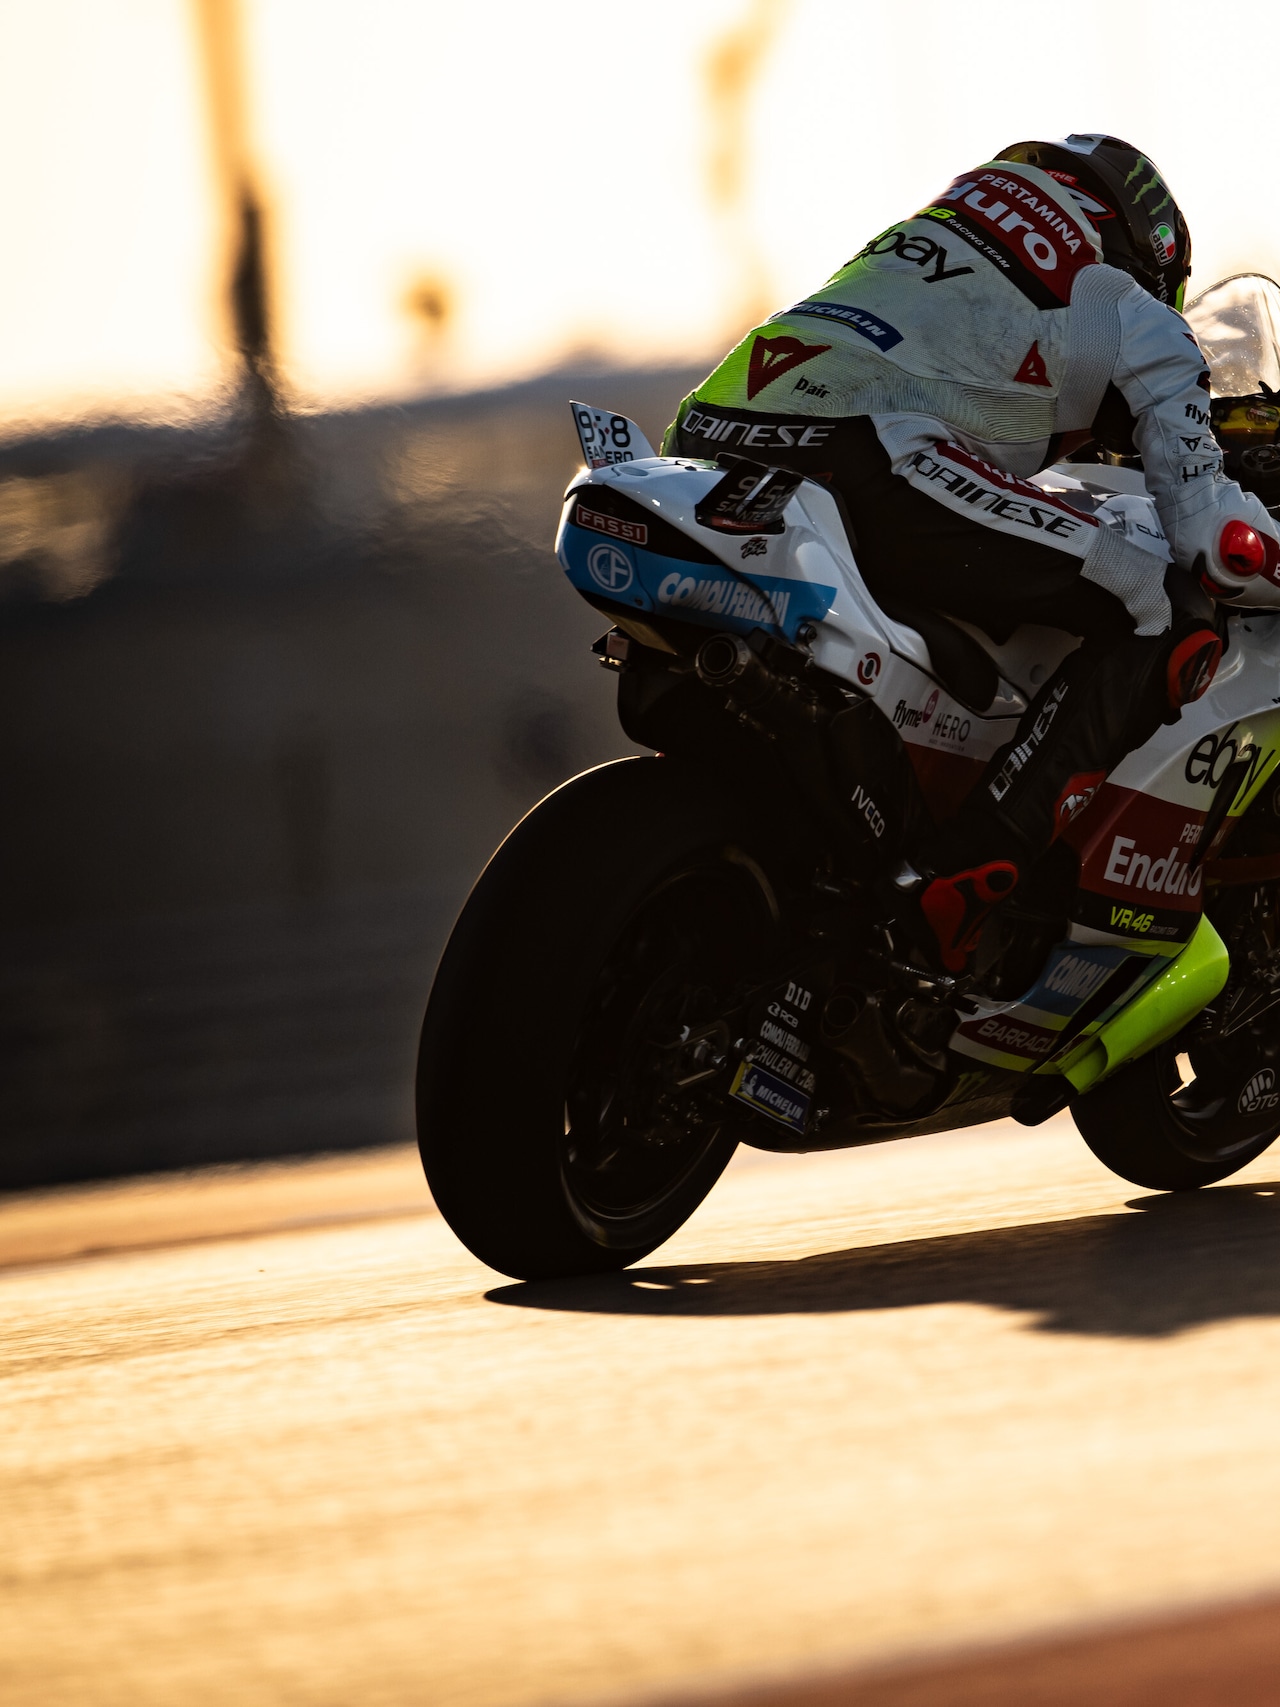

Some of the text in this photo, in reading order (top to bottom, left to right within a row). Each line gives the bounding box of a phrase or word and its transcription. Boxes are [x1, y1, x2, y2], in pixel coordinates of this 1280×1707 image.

[978, 173, 1082, 256] PERTAMINA
[866, 227, 976, 284] bay
[946, 217, 985, 246] RACING
[983, 245, 1011, 269] TEAM
[680, 408, 837, 448] DAINESE
[911, 451, 1082, 539] DAINESE
[581, 511, 641, 540] FASSI
[892, 699, 923, 729] flyme
[931, 712, 971, 742] HERO
[986, 680, 1069, 803] DAINESE
[850, 784, 886, 838] IVECO
[755, 1084, 804, 1120] MICHELIN
